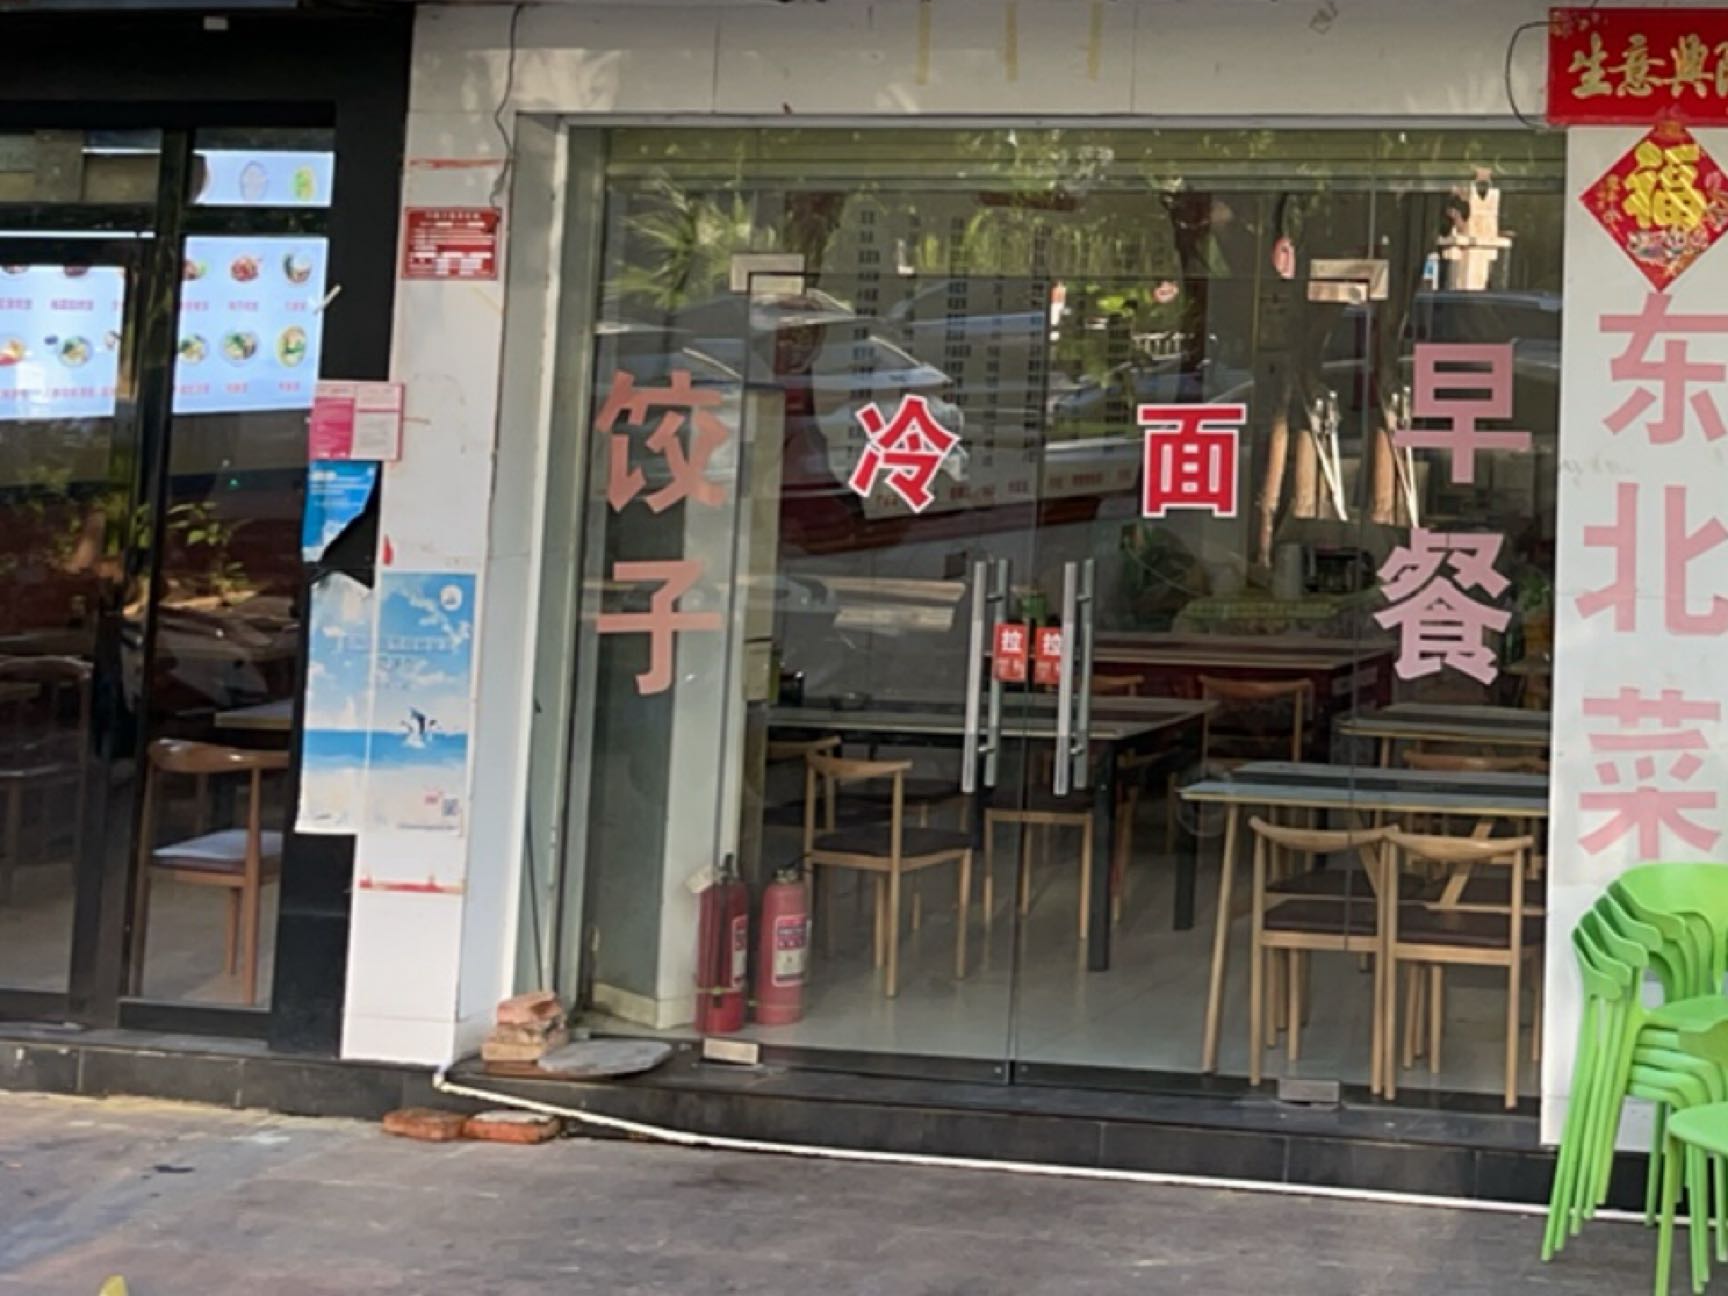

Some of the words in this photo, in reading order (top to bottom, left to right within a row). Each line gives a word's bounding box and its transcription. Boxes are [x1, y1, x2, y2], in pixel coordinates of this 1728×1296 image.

[1621, 141, 1707, 231] 福
[595, 369, 730, 696] 饺子
[1373, 343, 1533, 685] 早餐
[1001, 630, 1022, 652] 拉
